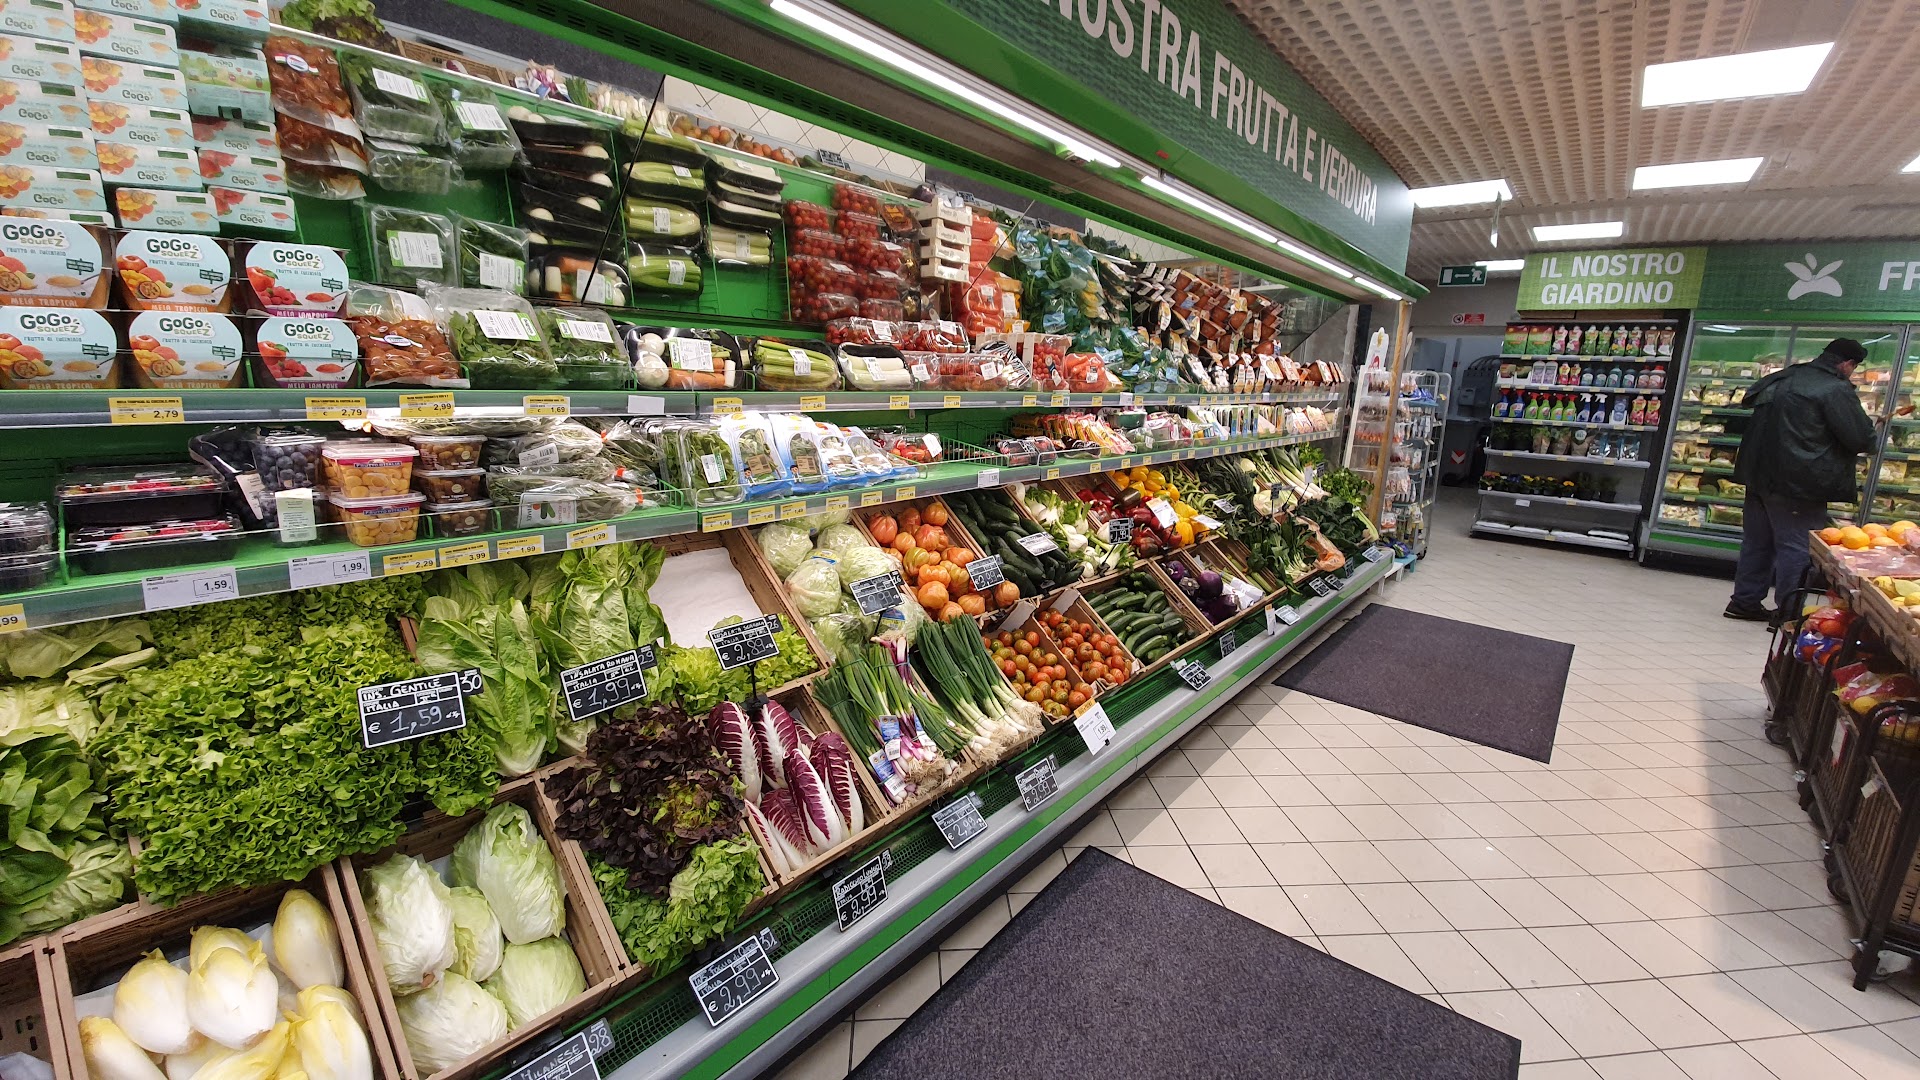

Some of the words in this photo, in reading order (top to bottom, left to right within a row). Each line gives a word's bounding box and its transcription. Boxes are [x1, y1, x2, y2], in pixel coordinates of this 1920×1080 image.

[1042, 0, 1201, 109] STRA
[1211, 50, 1299, 174] FRUTTA
[1303, 126, 1317, 183] E
[1318, 138, 1379, 227] VERDURA
[1540, 257, 1563, 278] IL
[1571, 252, 1686, 277] NOSTRO
[1541, 280, 1674, 305] GIARDINO
[153, 410, 179, 419] 2,79
[433, 403, 452, 411] 2,99
[593, 533, 606, 541] 1,29
[469, 553, 486, 561] 3,99
[521, 546, 536, 554] 1,99
[342, 562, 362, 572] 1,99
[416, 560, 434, 569] 2,29
[204, 579, 228, 592] 1,59
[638, 650, 655, 665] 29
[722, 652, 730, 661] €
[733, 638, 766, 662] 2,89
[569, 663, 606, 680] INSALATA
[606, 655, 635, 668] ROMANA
[362, 691, 388, 702] INS.
[390, 678, 442, 696] GENTILE
[459, 674, 482, 693] 30
[573, 678, 598, 691] ITALIA
[572, 698, 583, 709] €
[587, 678, 631, 709] 1,99
[366, 700, 401, 713] ITALIA
[367, 722, 382, 734] €
[389, 705, 443, 735] 1,59
[841, 910, 848, 922] €
[851, 885, 877, 920] 2,99
[708, 1000, 719, 1012] €
[719, 967, 761, 1012] 2,99
[588, 1027, 612, 1057] 28
